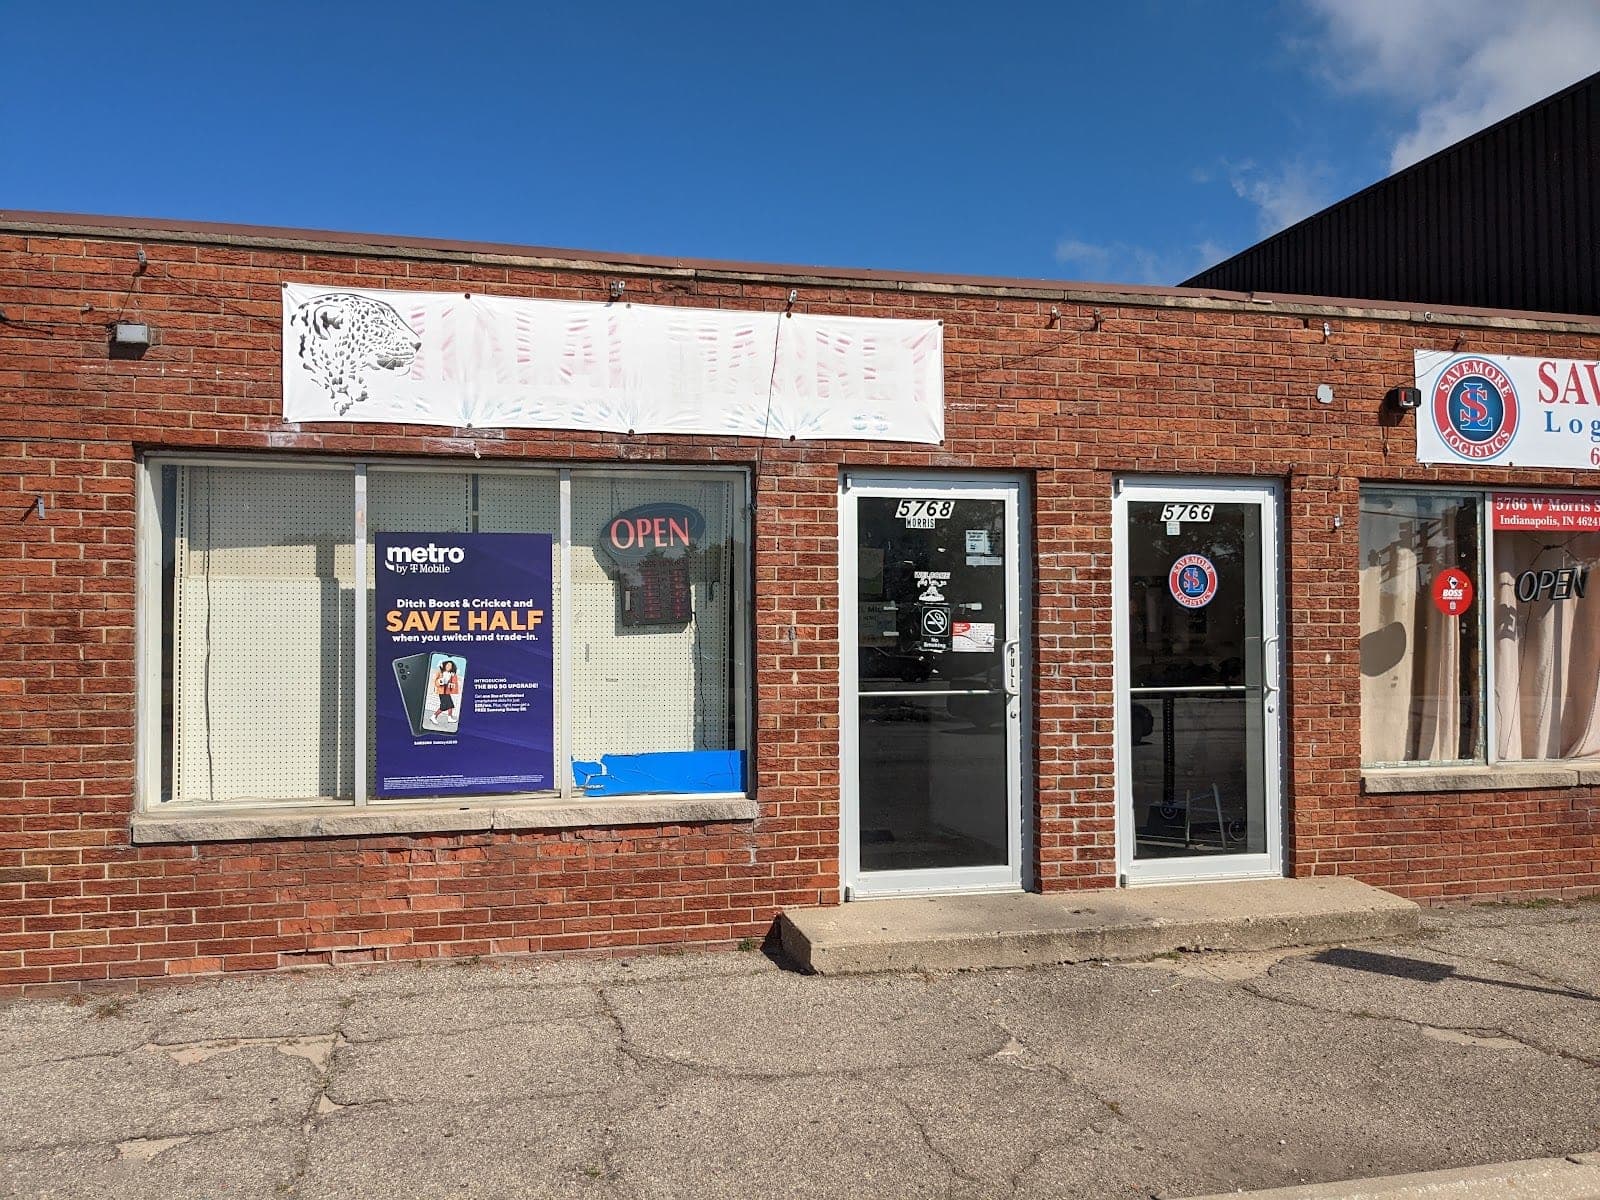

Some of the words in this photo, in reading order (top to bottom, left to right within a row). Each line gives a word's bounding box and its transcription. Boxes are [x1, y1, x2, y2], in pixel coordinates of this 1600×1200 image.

[1440, 361, 1512, 398] SAVEMORE
[1441, 426, 1511, 458] LOGISTICS
[898, 500, 953, 517] 5768
[1163, 504, 1212, 520] 5766
[1496, 496, 1527, 511] 5766
[1531, 497, 1546, 511] W
[1548, 498, 1591, 512] Morris
[906, 518, 935, 528] MORRIS
[1500, 514, 1560, 527] Indianapolis,
[1562, 515, 1574, 526] IN
[610, 516, 690, 550] OPEN
[386, 542, 465, 565] metro
[396, 563, 408, 576] by
[1173, 556, 1214, 575] SAVEMORE
[1442, 589, 1464, 597] BOSS
[1515, 567, 1588, 603] OPEN
[396, 598, 426, 608] Ditch
[428, 598, 460, 608] Boost
[462, 599, 470, 608] &
[472, 598, 512, 608] Cricket
[514, 598, 533, 608] and
[1175, 590, 1212, 607] LOGISTICS
[385, 610, 461, 632] SAVE
[468, 609, 544, 631] HALF
[392, 633, 419, 642] when
[421, 634, 440, 644] you
[441, 632, 474, 642] switch
[475, 632, 494, 642] and
[495, 632, 539, 642] trade-in.
